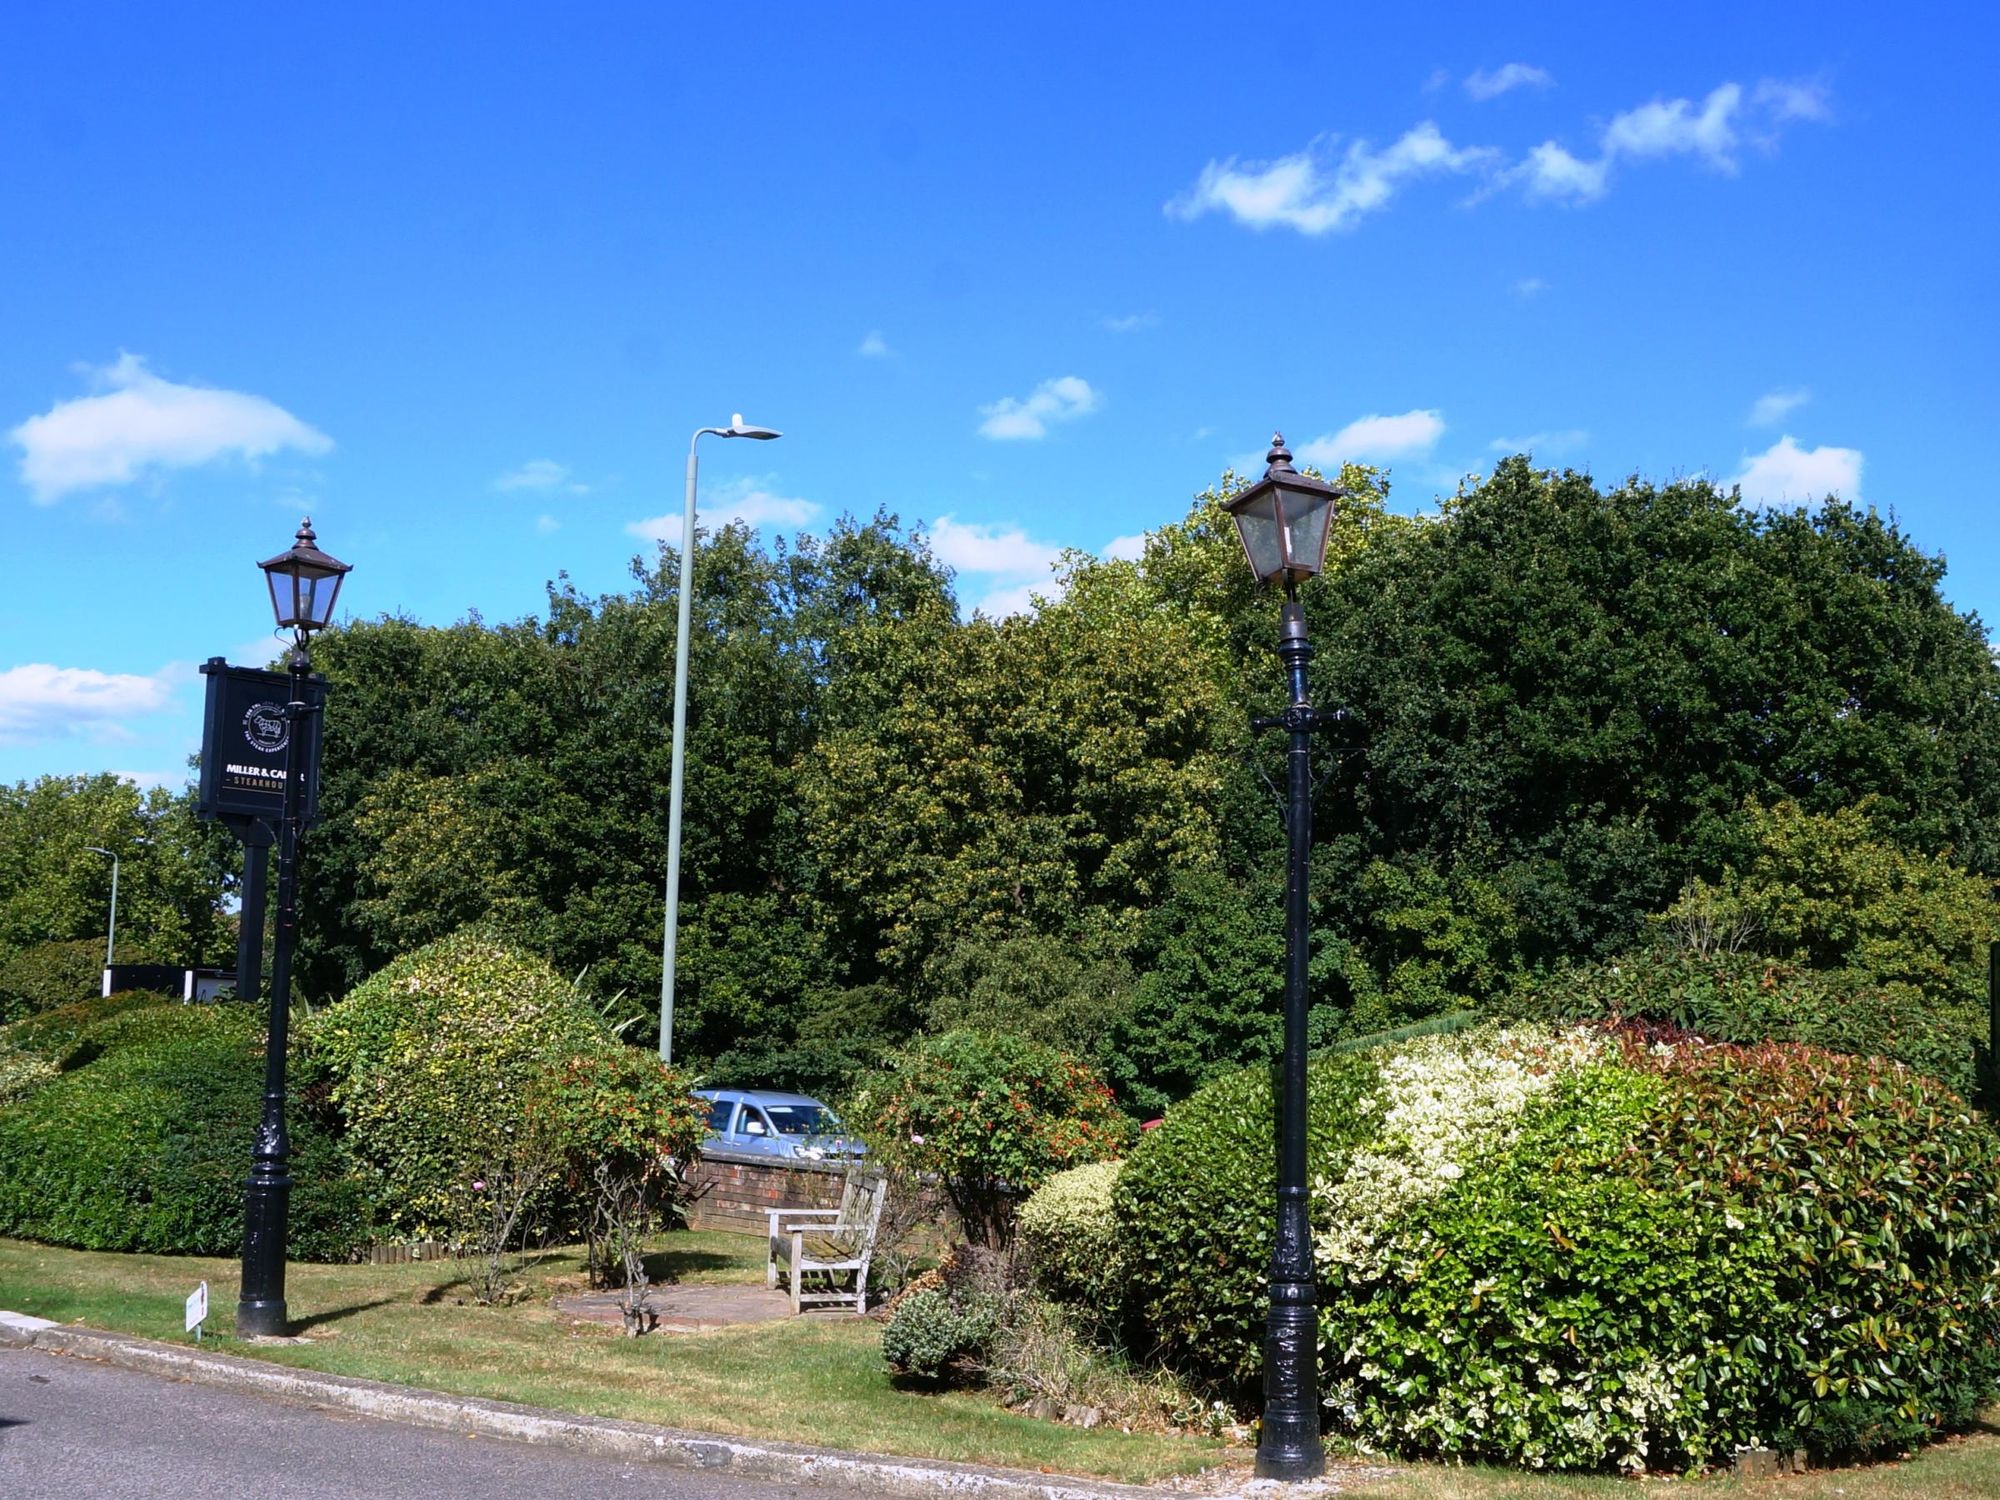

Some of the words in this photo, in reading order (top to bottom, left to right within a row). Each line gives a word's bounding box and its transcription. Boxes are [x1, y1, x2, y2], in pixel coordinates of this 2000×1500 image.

[226, 763, 260, 777] MILLER
[261, 768, 270, 777] &
[233, 776, 283, 789] STEAKHOU
